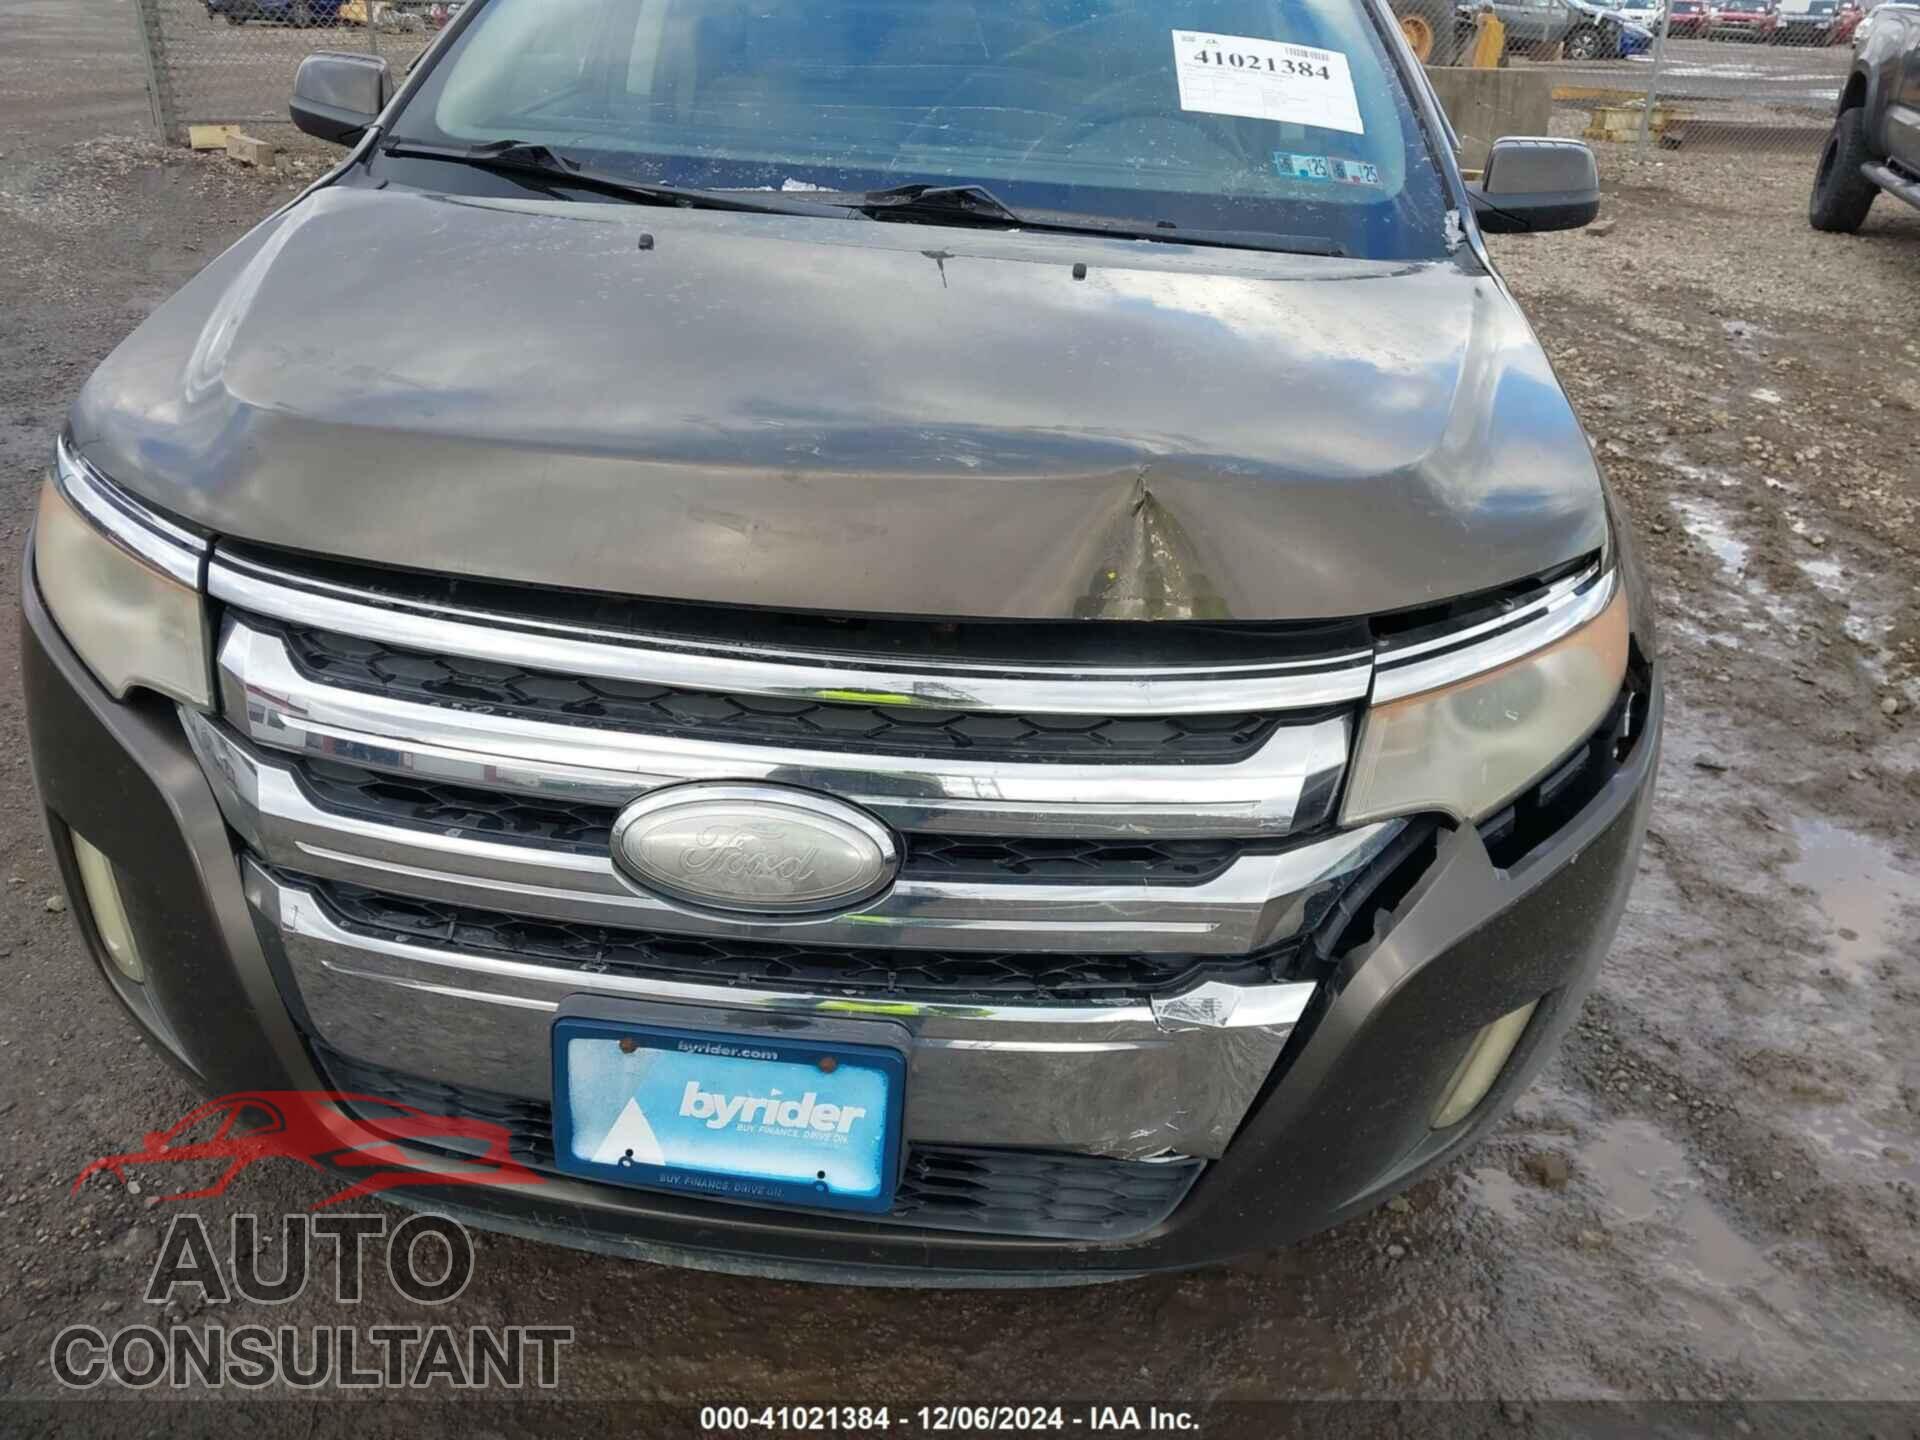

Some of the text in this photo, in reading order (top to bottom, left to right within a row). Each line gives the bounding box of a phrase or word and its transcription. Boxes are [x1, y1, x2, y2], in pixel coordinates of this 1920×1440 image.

[1194, 50, 1331, 80] 41021384
[679, 823, 818, 880] Ford
[678, 1040, 779, 1061] byrider.com
[679, 1081, 867, 1133] byrider
